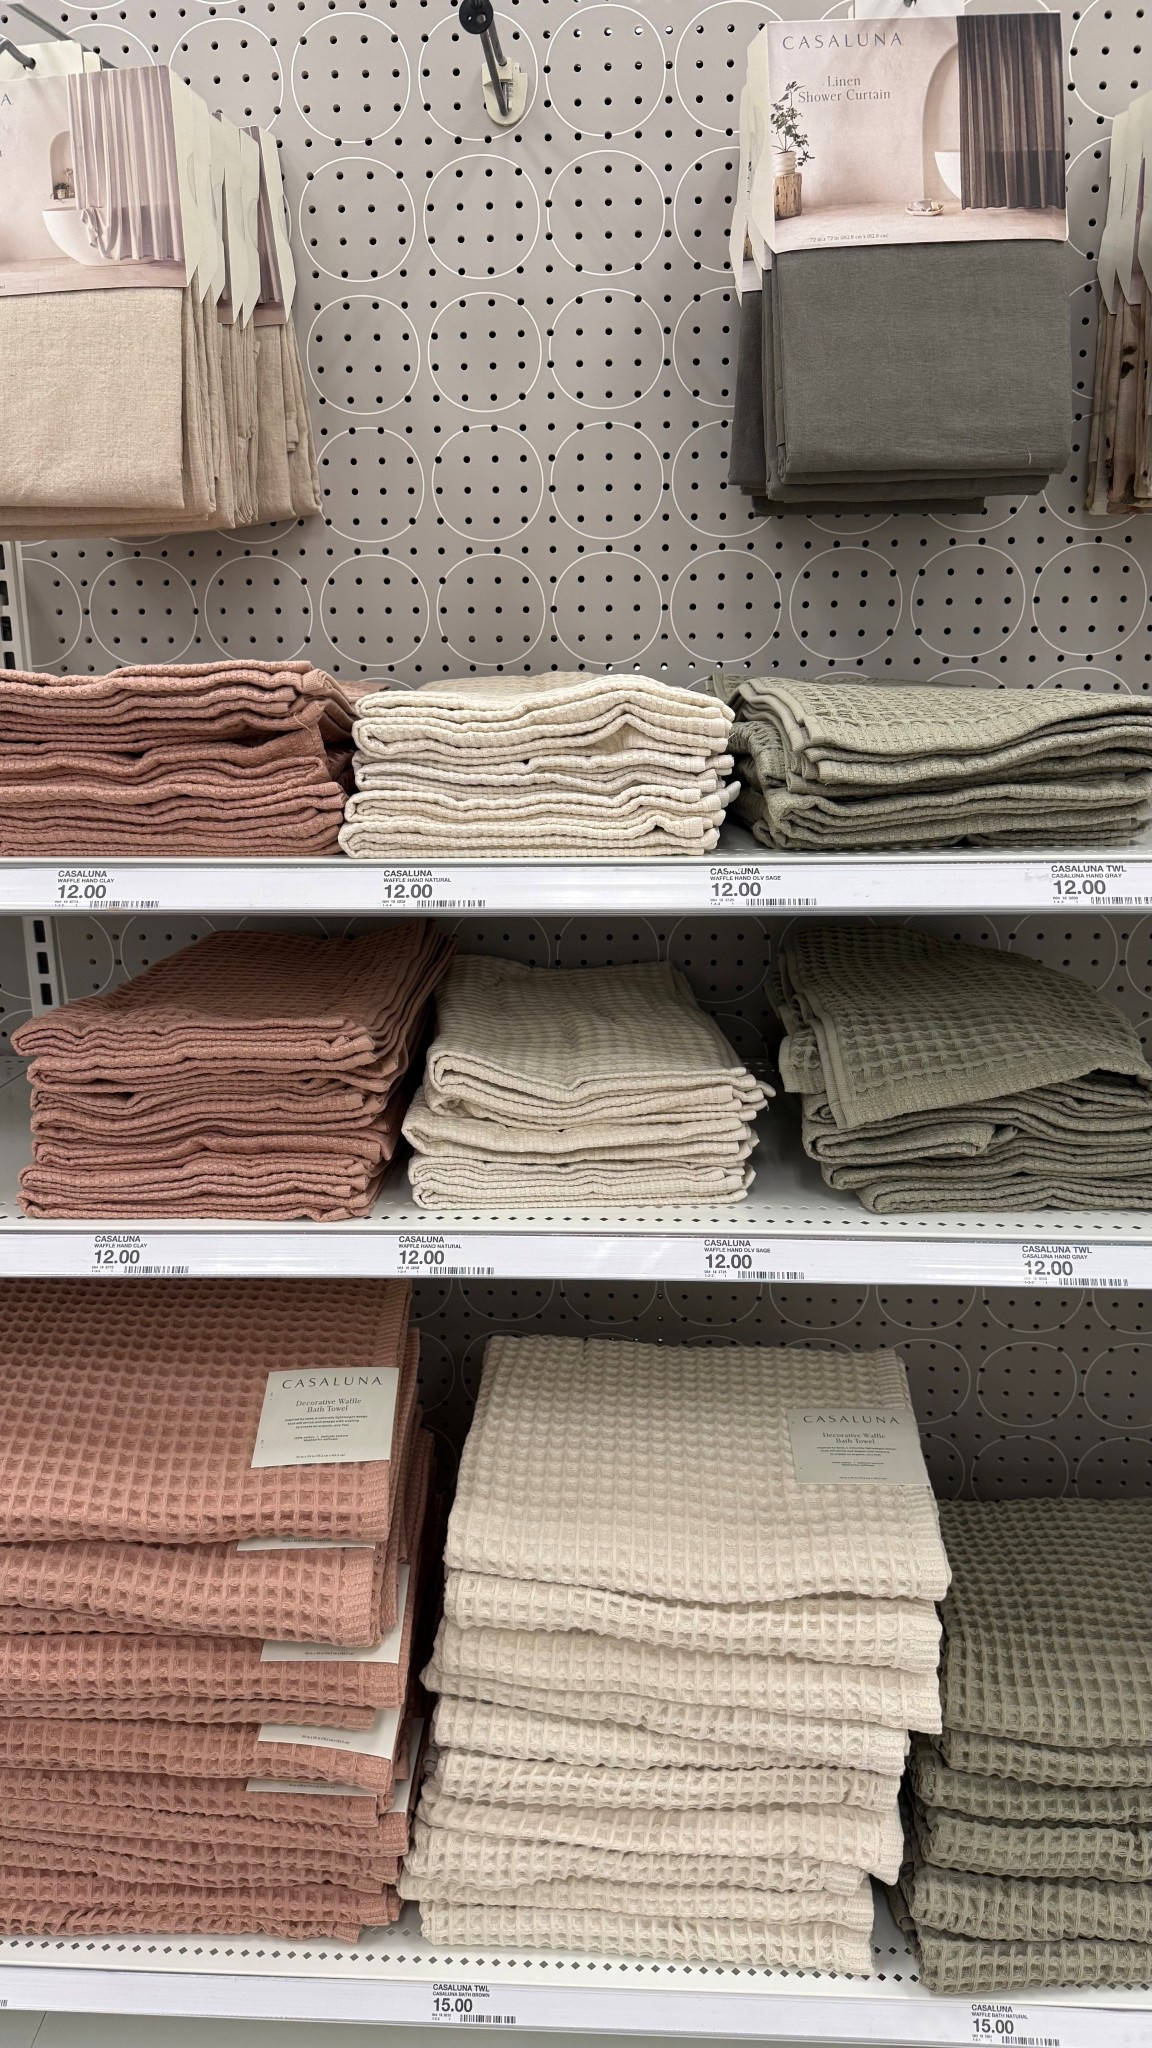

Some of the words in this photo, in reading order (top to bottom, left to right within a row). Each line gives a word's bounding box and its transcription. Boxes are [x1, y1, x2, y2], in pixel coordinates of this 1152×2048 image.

[782, 32, 903, 50] CASALUNA
[827, 75, 861, 87] Linen
[798, 91, 842, 103] Shower
[846, 88, 891, 101] Curtain
[58, 885, 107, 898] 12.00
[384, 884, 433, 898] 12.00
[711, 882, 761, 896] 12.00
[1053, 880, 1106, 894] 12.00
[704, 1239, 751, 1247] CASALUNA
[1022, 1245, 1071, 1254] CASALUNA
[1073, 1246, 1093, 1254] TWL
[94, 1250, 140, 1264] 12.00
[399, 1250, 445, 1264] 12.00
[705, 1254, 752, 1269] 12.00
[1024, 1260, 1073, 1276] 12.00
[282, 1376, 383, 1390] CASALUNA
[295, 1399, 336, 1407] Decorative
[338, 1397, 362, 1405] Waffle
[327, 1404, 348, 1412] Towel
[803, 1415, 900, 1424] CASALUNA
[432, 1983, 473, 1992] CASALUNA
[474, 1984, 490, 1992] TWL
[433, 1997, 473, 2013] 15.00
[971, 2003, 1013, 2013] CASALUNA
[973, 2018, 1014, 2034] 15.00
